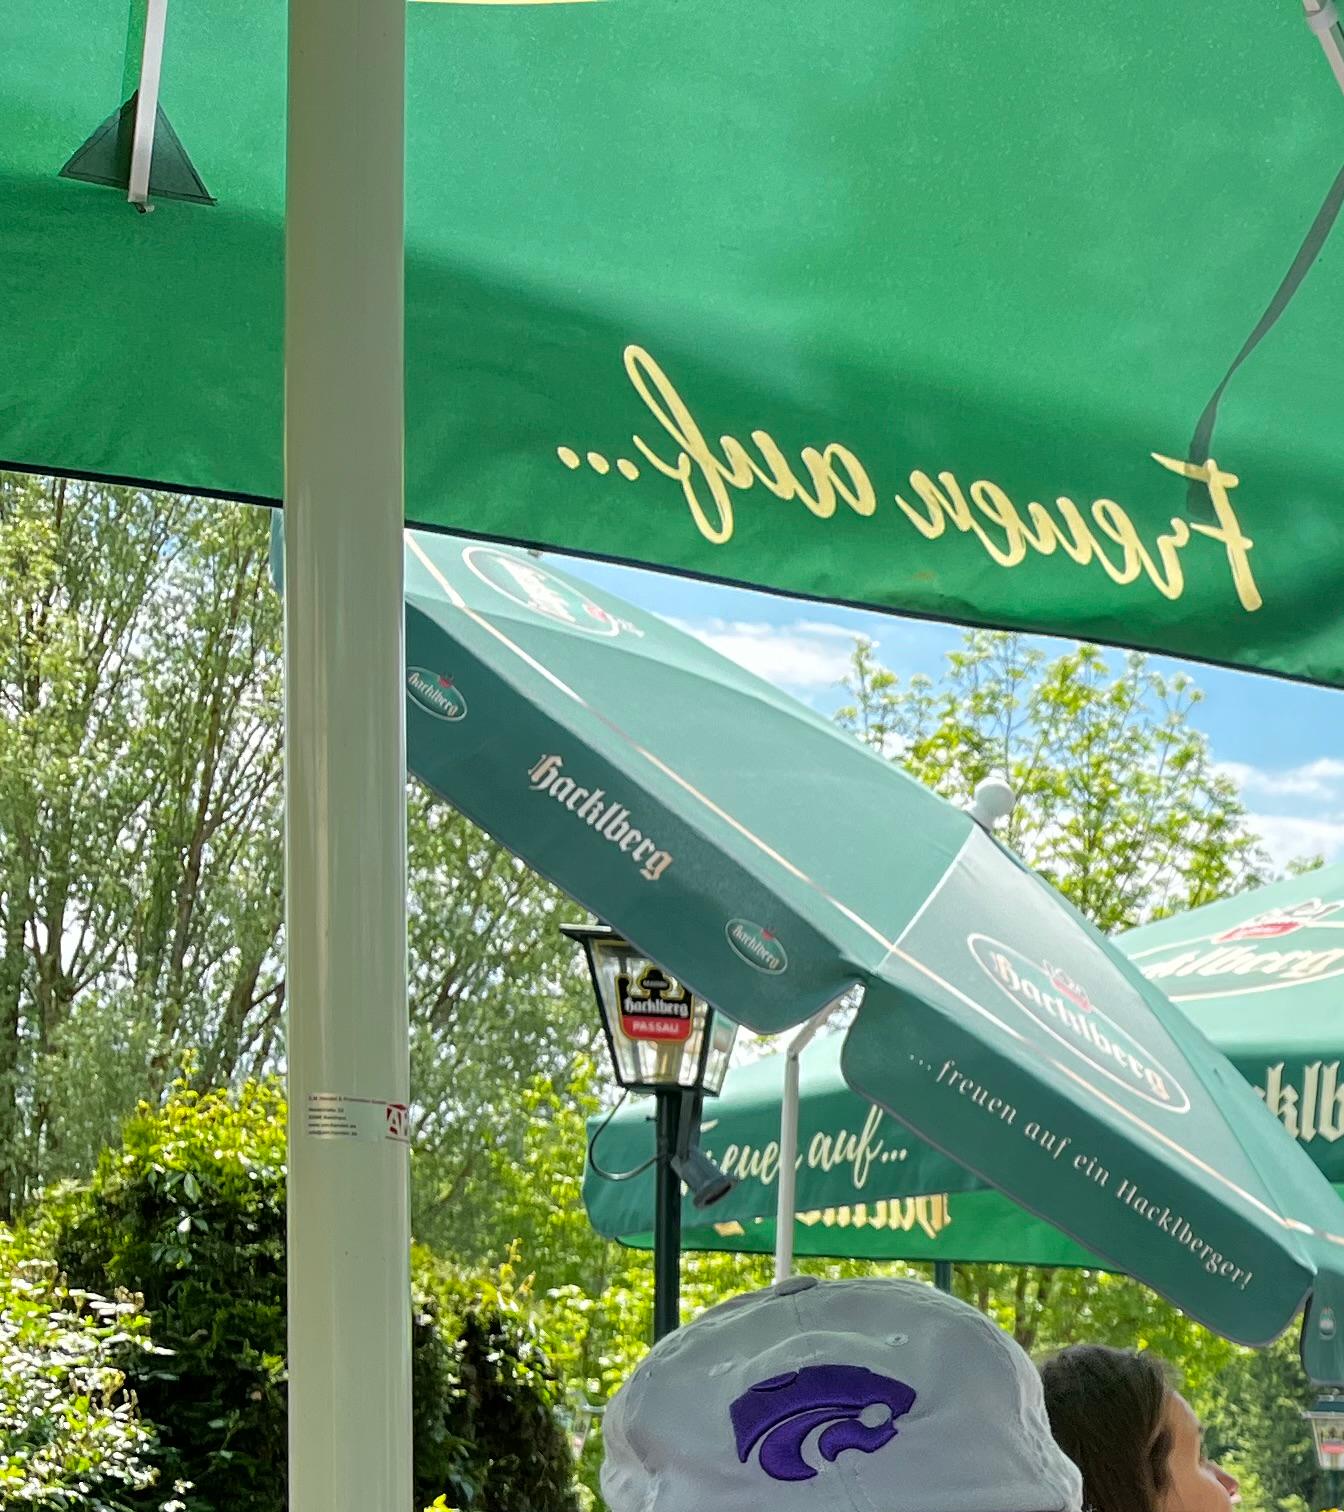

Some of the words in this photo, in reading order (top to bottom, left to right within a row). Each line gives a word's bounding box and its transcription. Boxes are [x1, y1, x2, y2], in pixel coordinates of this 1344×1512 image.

[528, 753, 673, 881] Hacklberg
[732, 924, 780, 970] Hacklberg
[624, 999, 689, 1017] Hacklberg
[632, 1020, 680, 1034] PASSAU
[990, 951, 1170, 1100] Hacklberg
[1023, 1118, 1072, 1160] auf
[1073, 1152, 1111, 1187] ein
[1115, 1178, 1254, 1290] Hacklberger!
